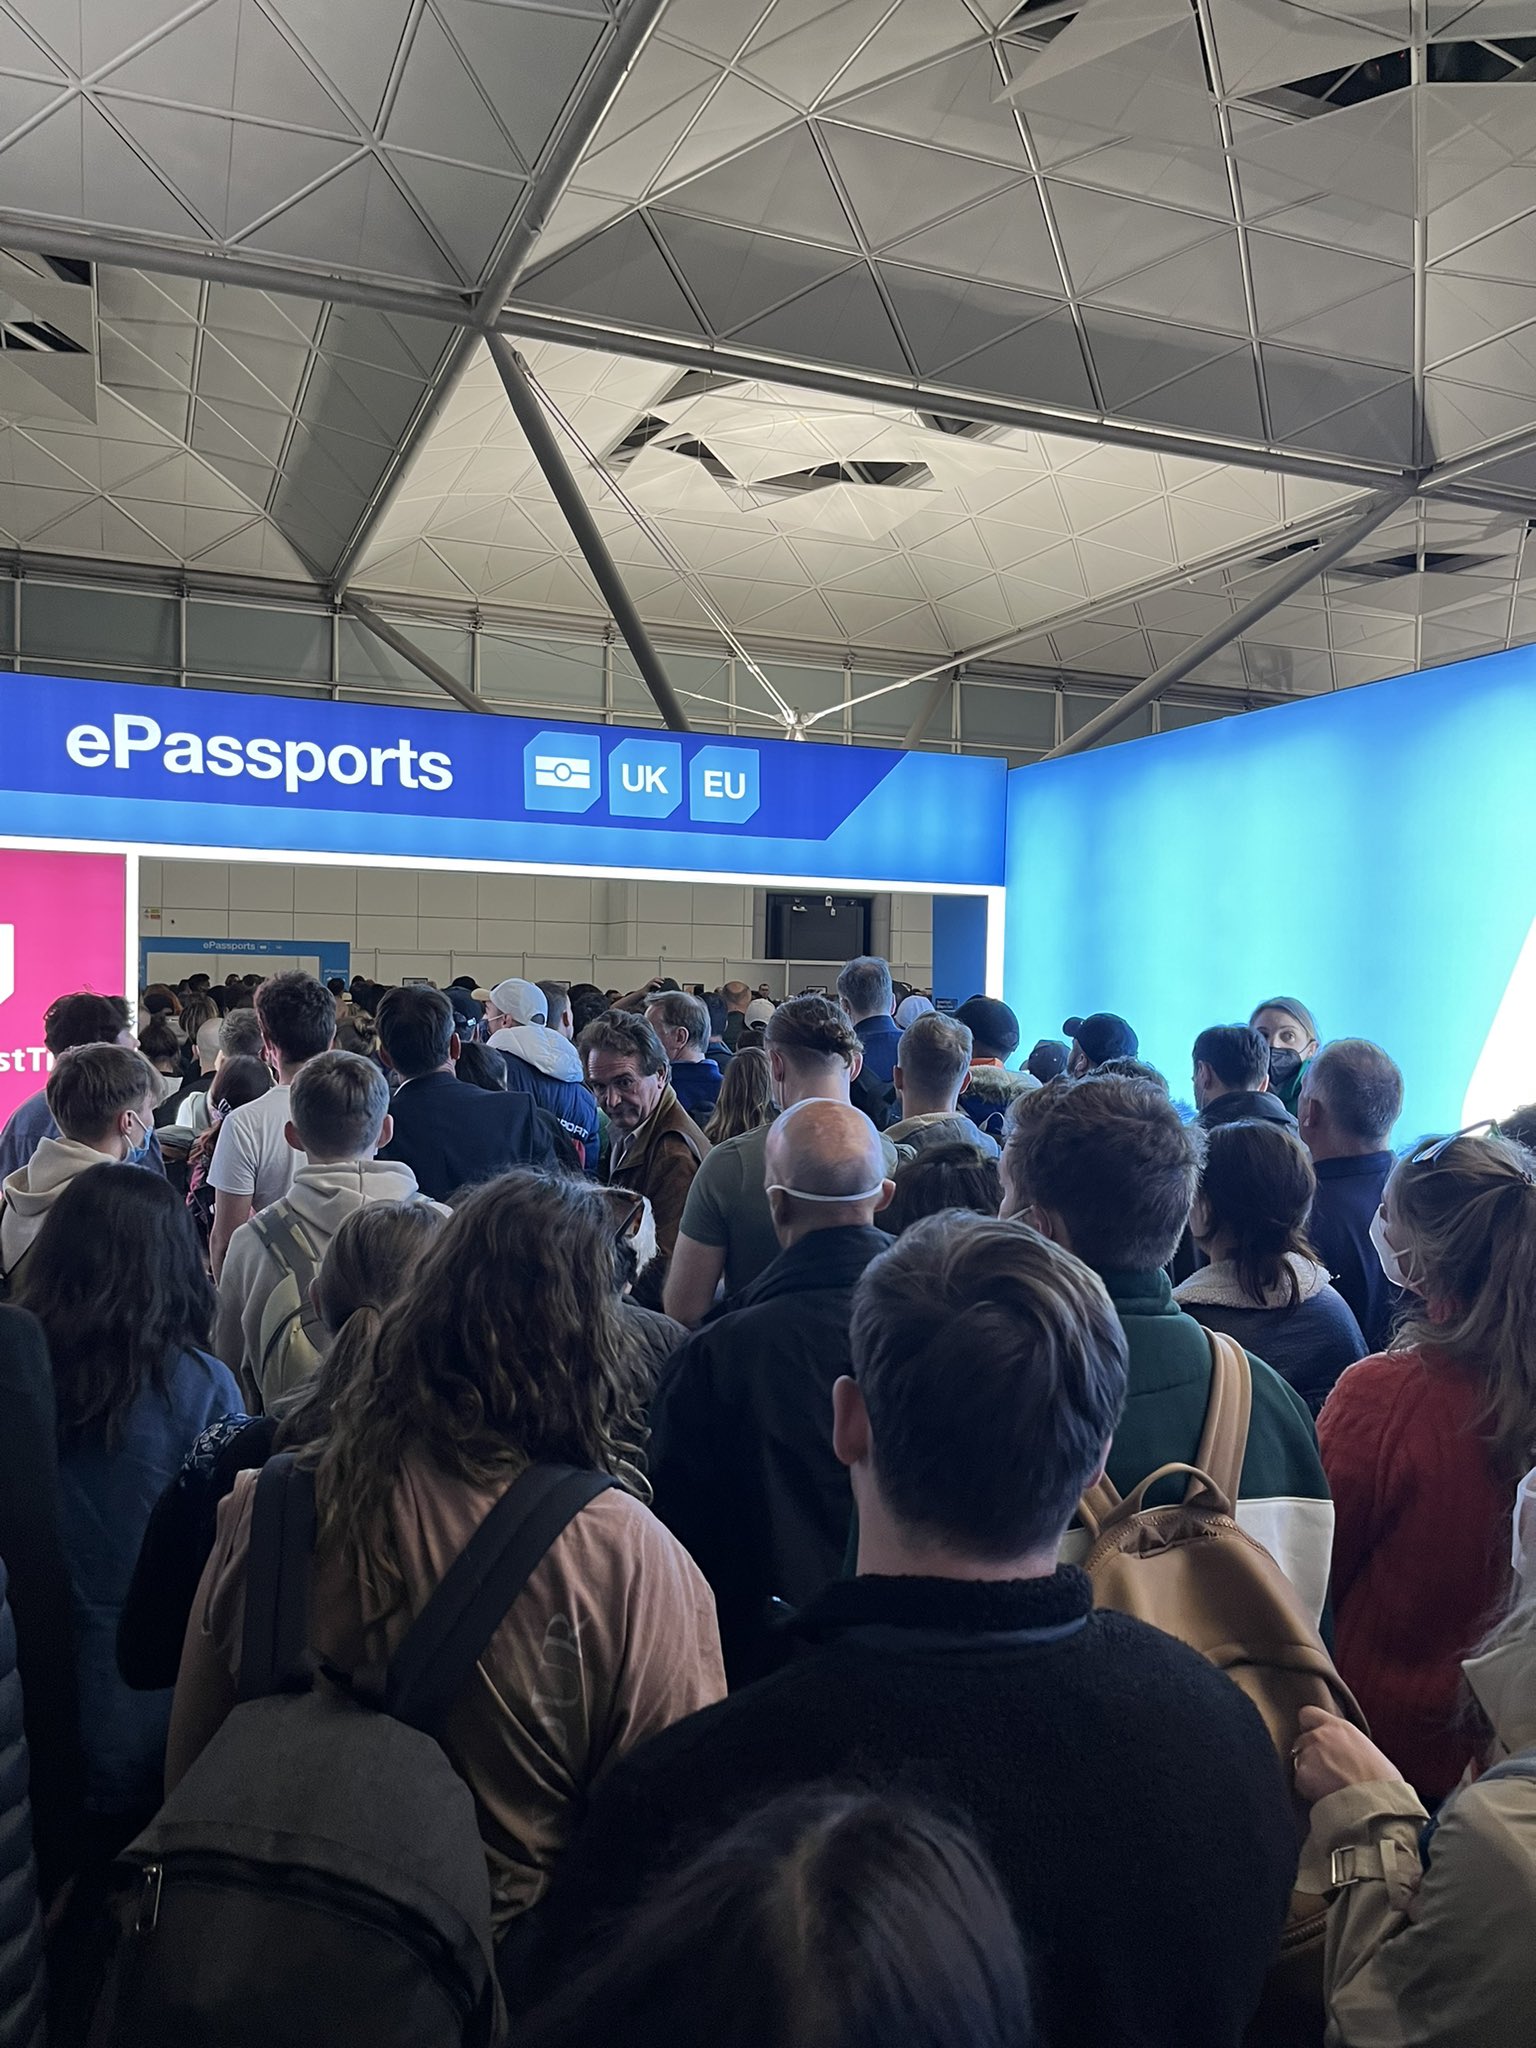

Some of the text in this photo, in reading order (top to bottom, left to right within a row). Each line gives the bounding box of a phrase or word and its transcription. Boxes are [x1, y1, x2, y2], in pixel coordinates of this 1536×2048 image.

[66, 713, 746, 799] ePassports UK EU
[202, 940, 256, 952] ePassports
[557, 1118, 589, 1138] PORT
